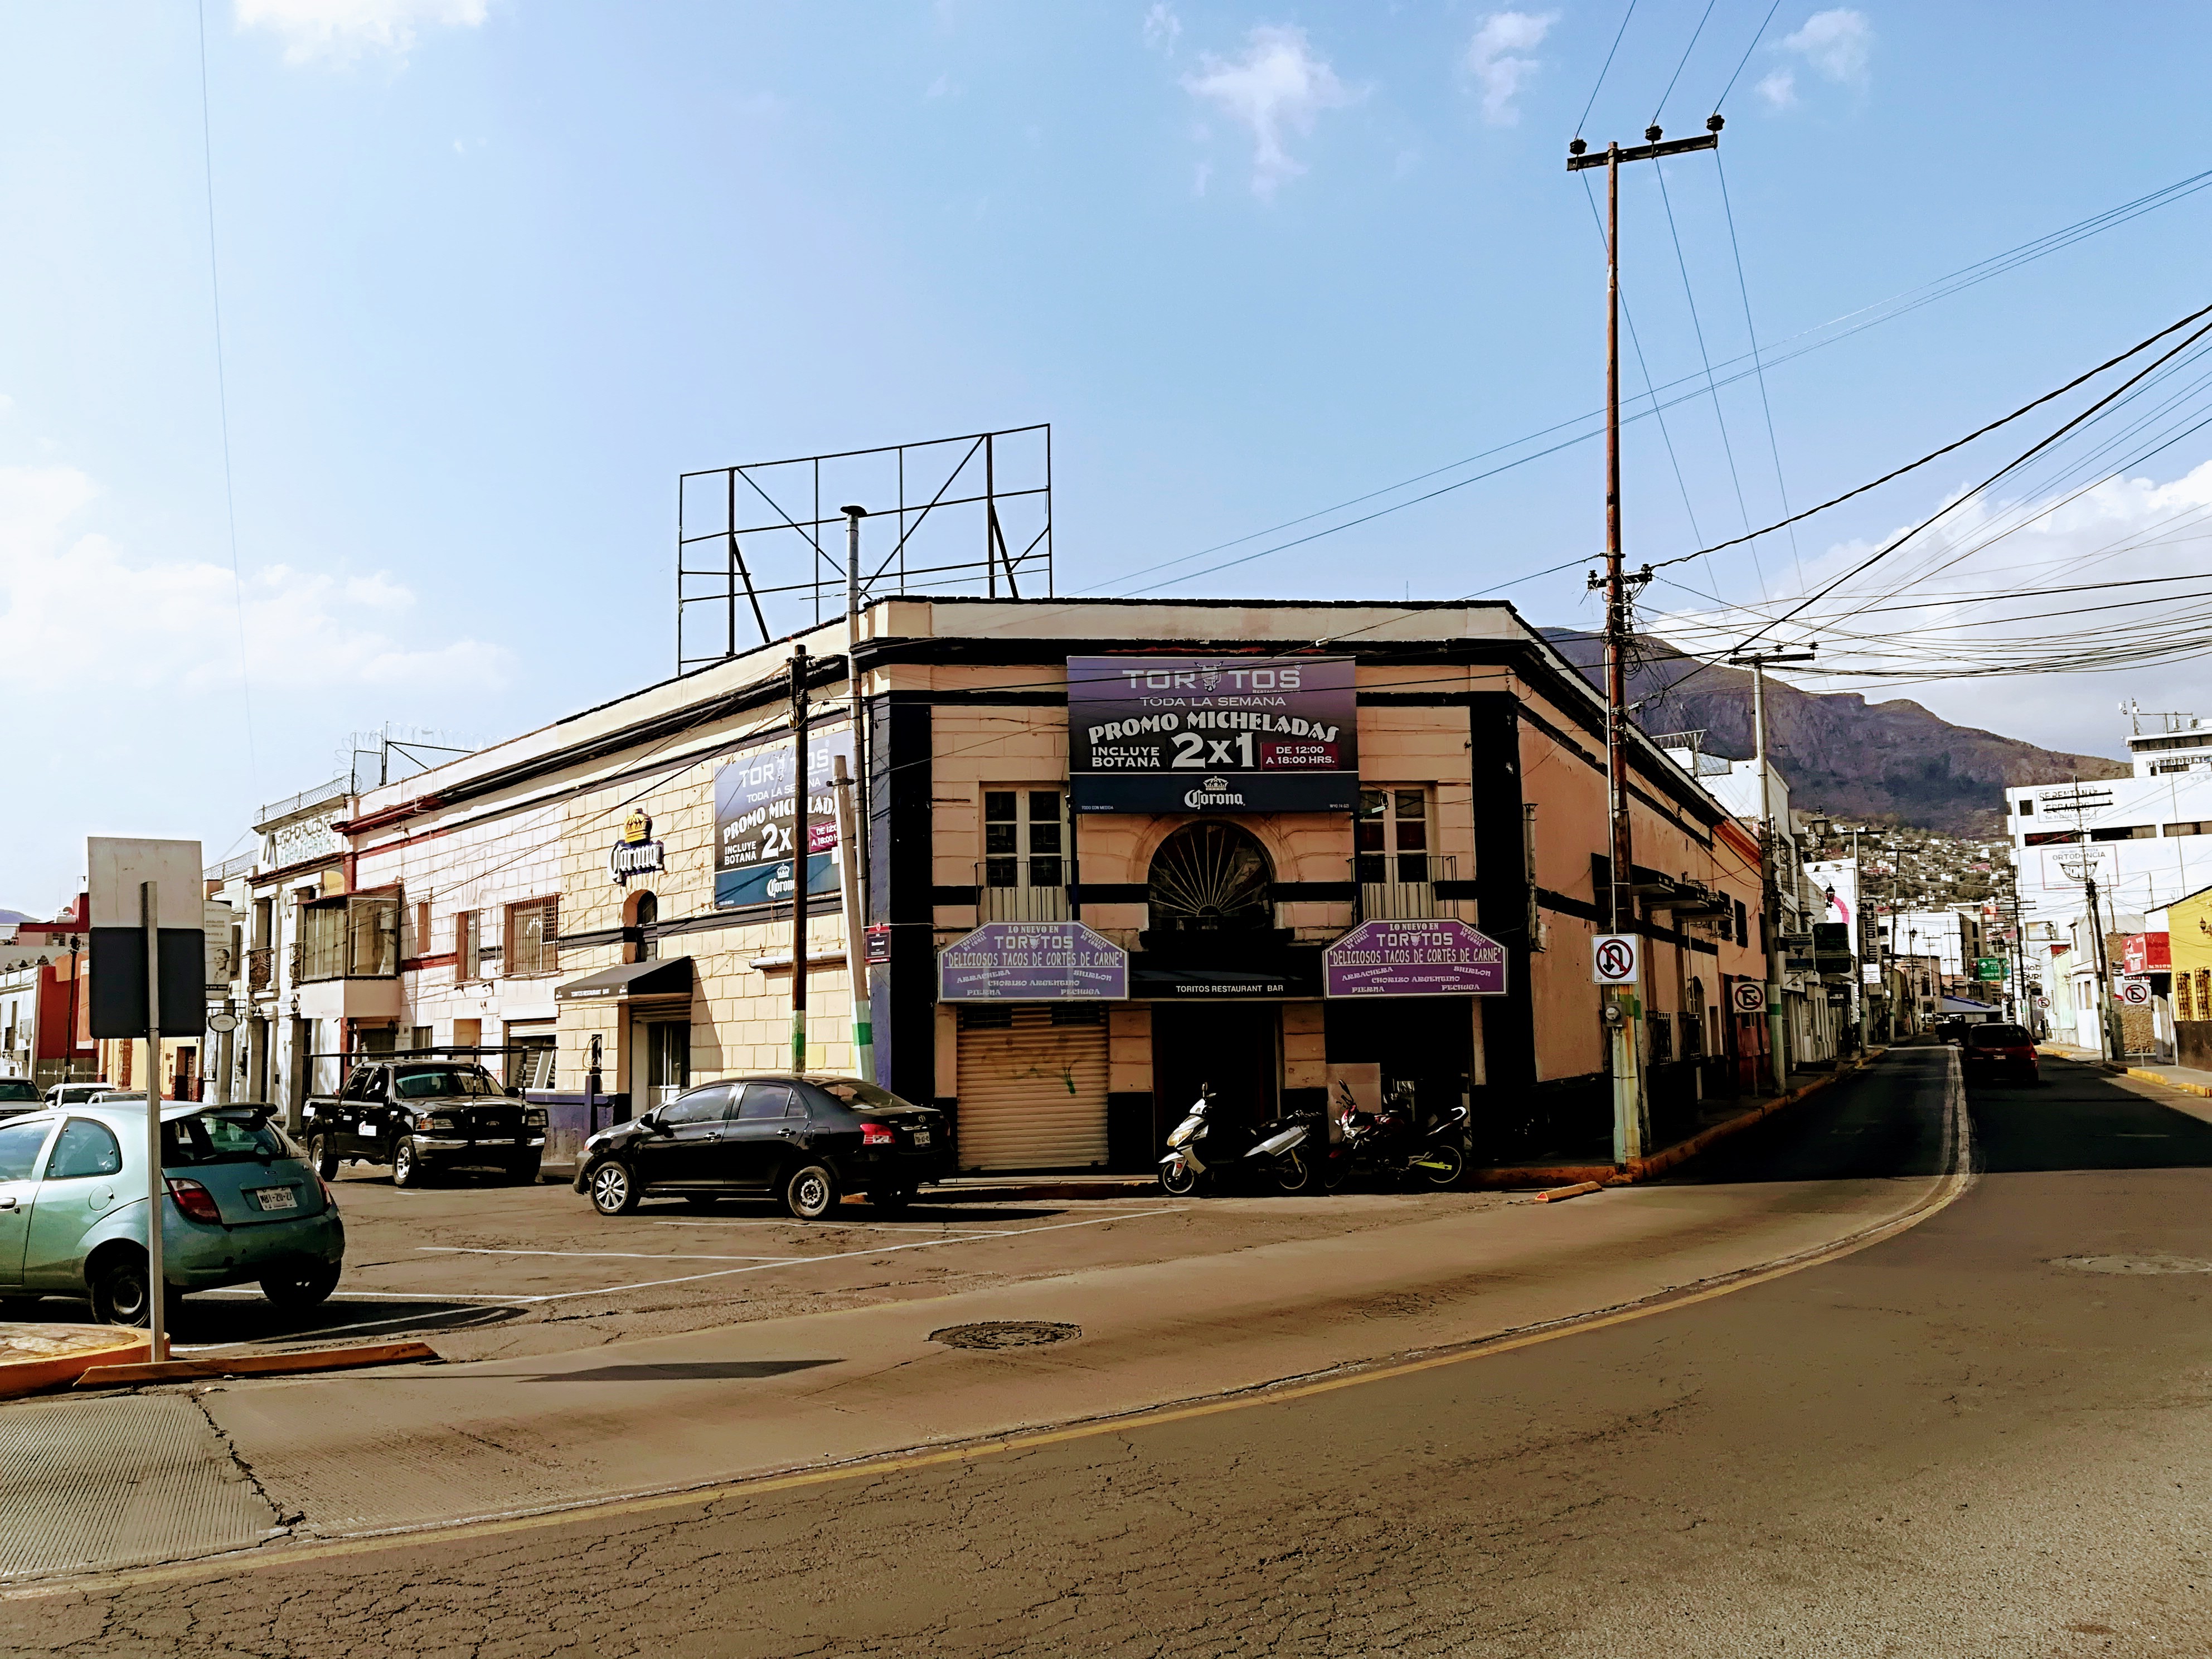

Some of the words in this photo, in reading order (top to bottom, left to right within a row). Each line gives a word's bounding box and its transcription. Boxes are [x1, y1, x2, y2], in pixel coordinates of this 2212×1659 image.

[1139, 697, 1186, 707] TODA
[1191, 697, 1213, 706] LA
[1217, 697, 1287, 706] SEMANA
[1088, 713, 1179, 745] PROMO
[1186, 711, 1340, 743] MICHELADAS
[1092, 747, 1160, 756] INCLUYE
[1275, 746, 1292, 754] DE
[1295, 746, 1325, 754] 12:00
[1092, 757, 1161, 767] BOTANA
[1265, 756, 1275, 764] A
[1278, 756, 1307, 764] 18:00
[1308, 756, 1335, 764] HRS.
[746, 792, 769, 803] TODA
[771, 788, 783, 798] LA
[784, 777, 821, 793] SENA
[1184, 788, 1244, 809] Corona
[724, 807, 766, 845] PROMO
[724, 841, 756, 855] INCLUYE
[816, 827, 826, 836] DE
[724, 852, 757, 866] BOTANA
[817, 835, 833, 845] 18:00
[607, 842, 659, 882] Corona
[767, 877, 795, 898] Coron
[1021, 925, 1047, 934] NUEVO
[1402, 923, 1427, 931] NUEVO
[1462, 925, 1486, 943] TORTILLAS
[959, 930, 986, 948] TORTILLAS
[1082, 929, 1108, 948] TORTILLAS
[1342, 928, 1368, 947] TORTILLAS
[1002, 952, 1029, 966] TACOS
[1032, 951, 1042, 967] DE
[1046, 951, 1076, 967] CORTES
[1080, 951, 1090, 967] DE
[1384, 949, 1410, 963] TACOS
[1414, 948, 1424, 963] DE
[1427, 948, 1456, 963] CORTES
[1459, 948, 1470, 962] DE
[957, 969, 1011, 984] ARRACHERA
[1342, 966, 1394, 981] ARRACHERA
